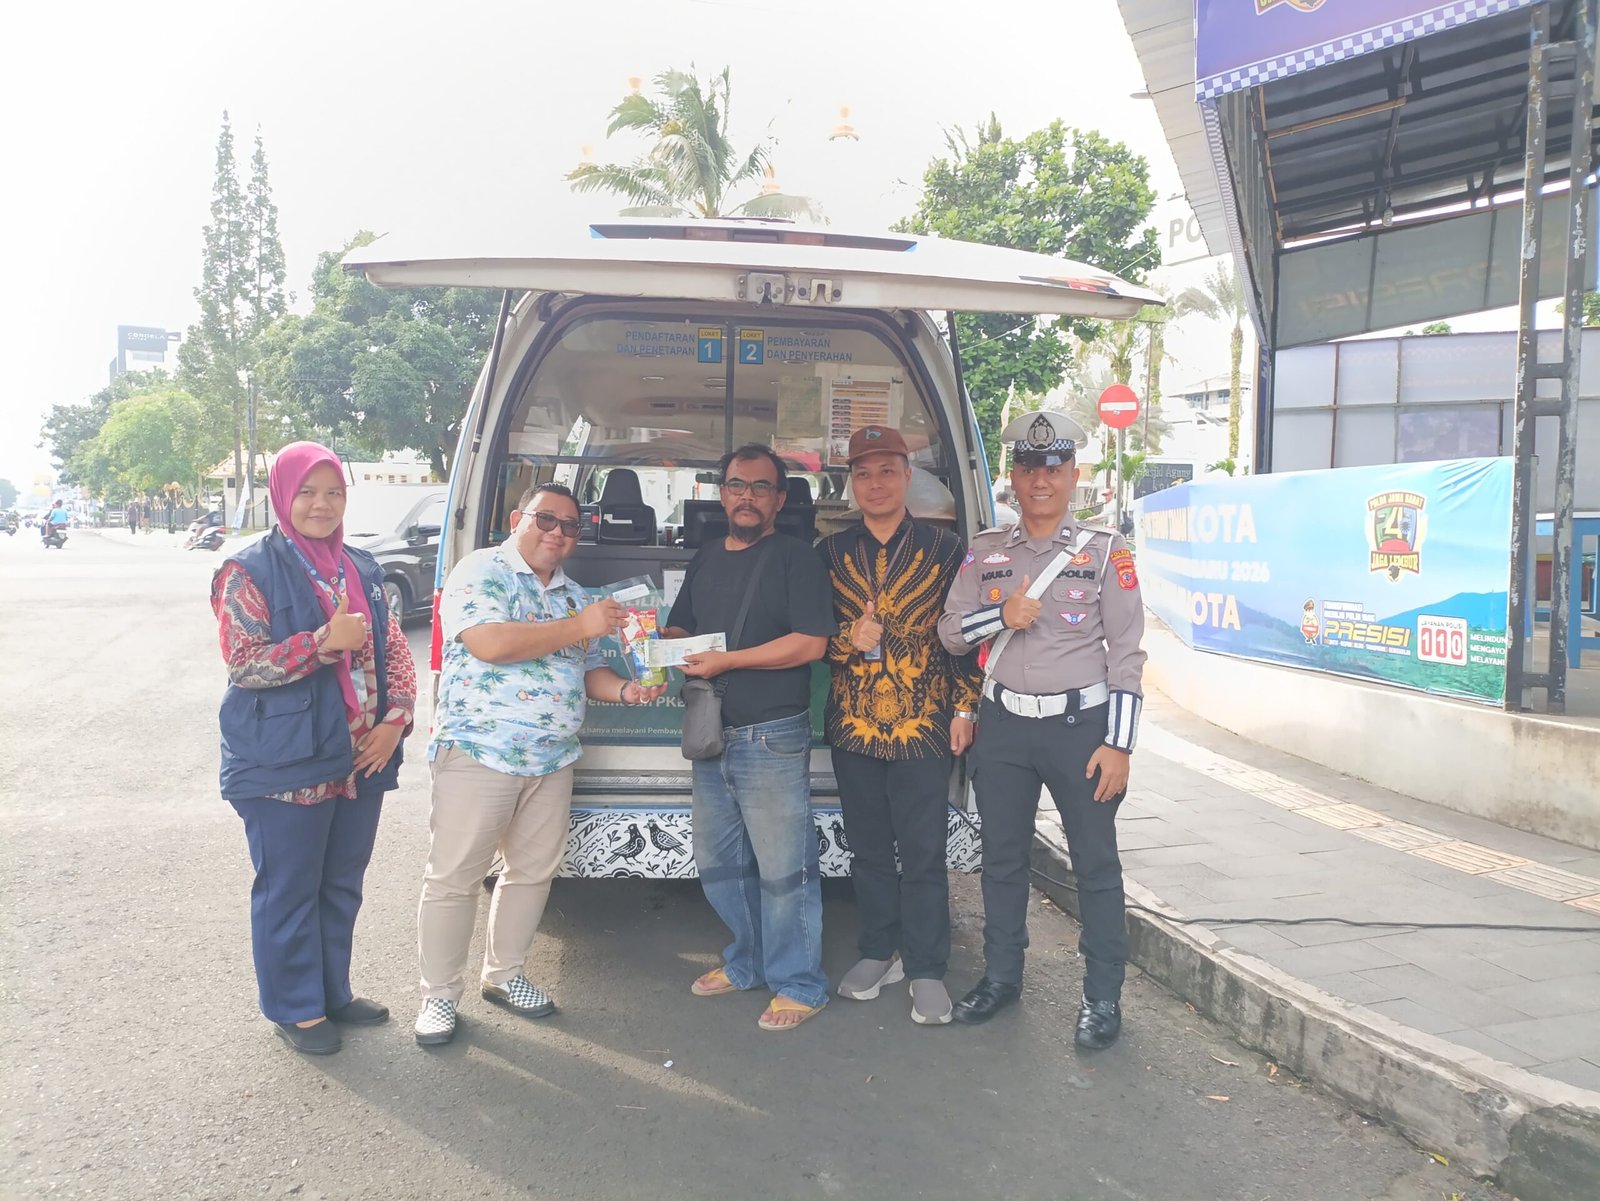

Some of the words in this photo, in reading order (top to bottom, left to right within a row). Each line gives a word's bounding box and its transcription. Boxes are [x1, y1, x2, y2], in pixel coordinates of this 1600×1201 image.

[625, 330, 695, 343] PENDAFTARAN
[742, 331, 761, 339] LOKET
[767, 336, 831, 348] PEMBAYARAN
[617, 343, 636, 353] DAN
[639, 344, 695, 356] PENETAPAN
[704, 341, 712, 358] 1
[746, 343, 757, 360] 2
[767, 350, 786, 359] DAN
[789, 351, 852, 361] PENYERAHAN
[1324, 620, 1411, 648] PRESISI
[1422, 630, 1463, 657] 110
[611, 727, 646, 735] melayani
